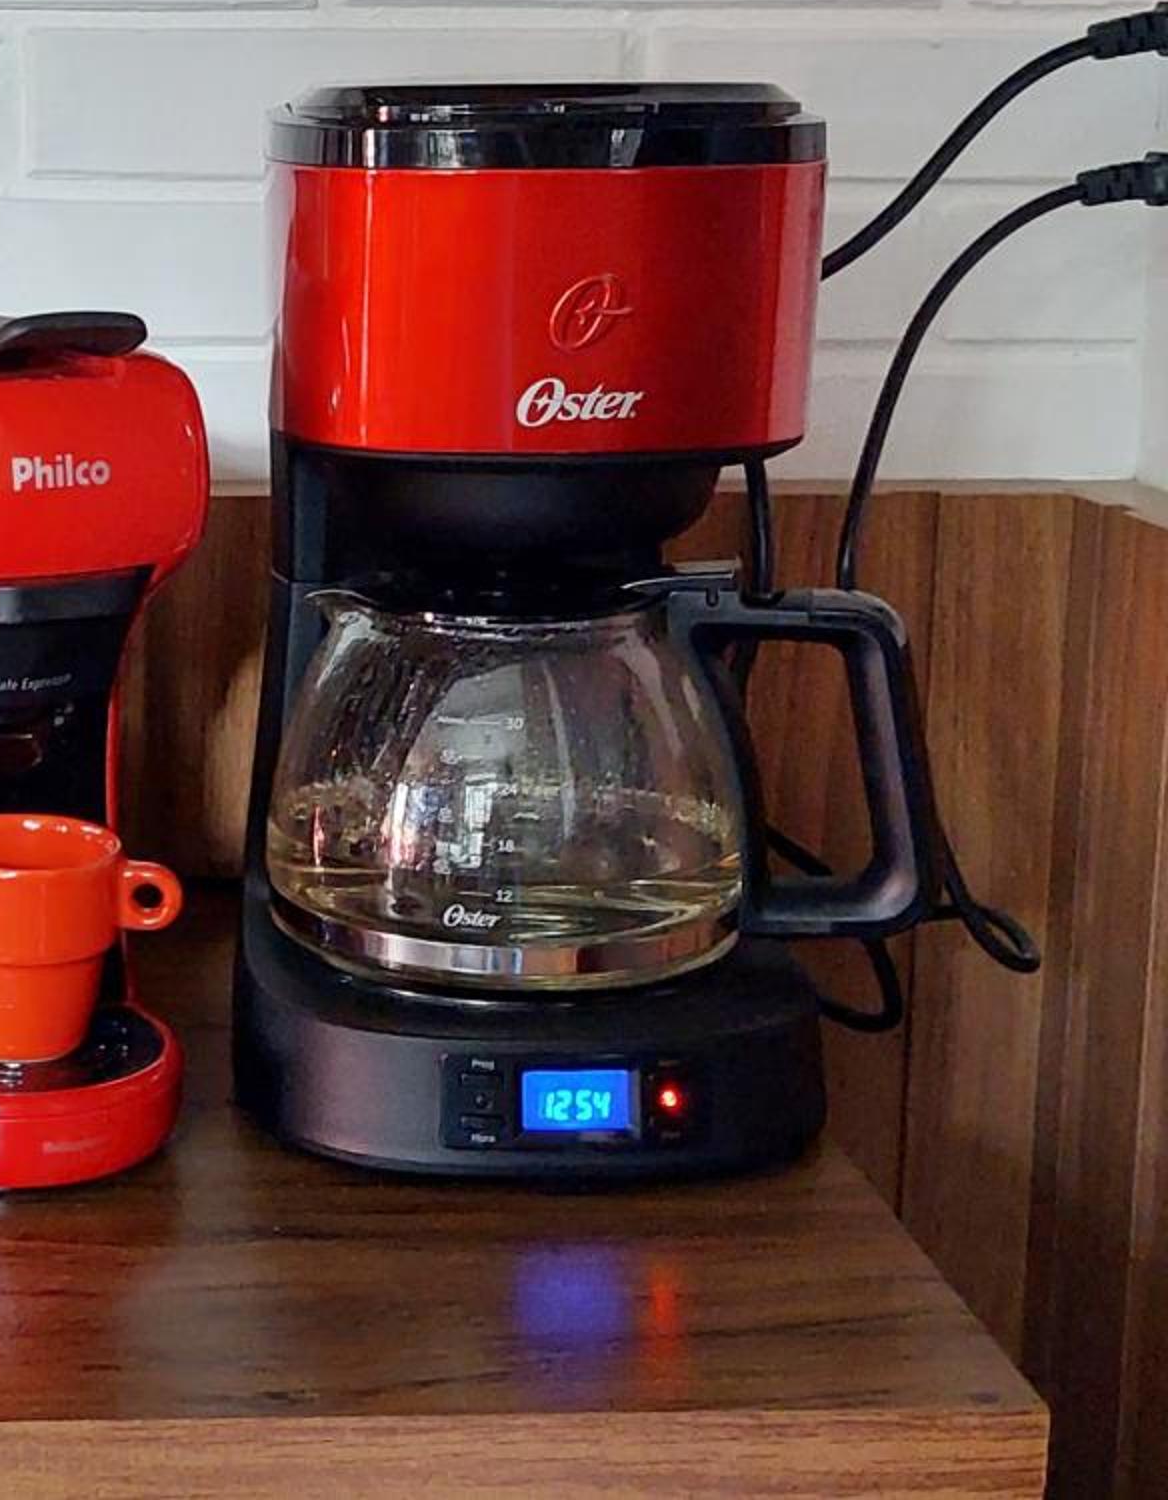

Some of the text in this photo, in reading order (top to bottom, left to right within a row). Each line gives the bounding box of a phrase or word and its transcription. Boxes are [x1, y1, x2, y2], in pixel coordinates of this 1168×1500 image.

[515, 376, 643, 428] Oster
[11, 453, 111, 492] Philco
[495, 889, 513, 903] 12
[442, 903, 502, 928] Oster
